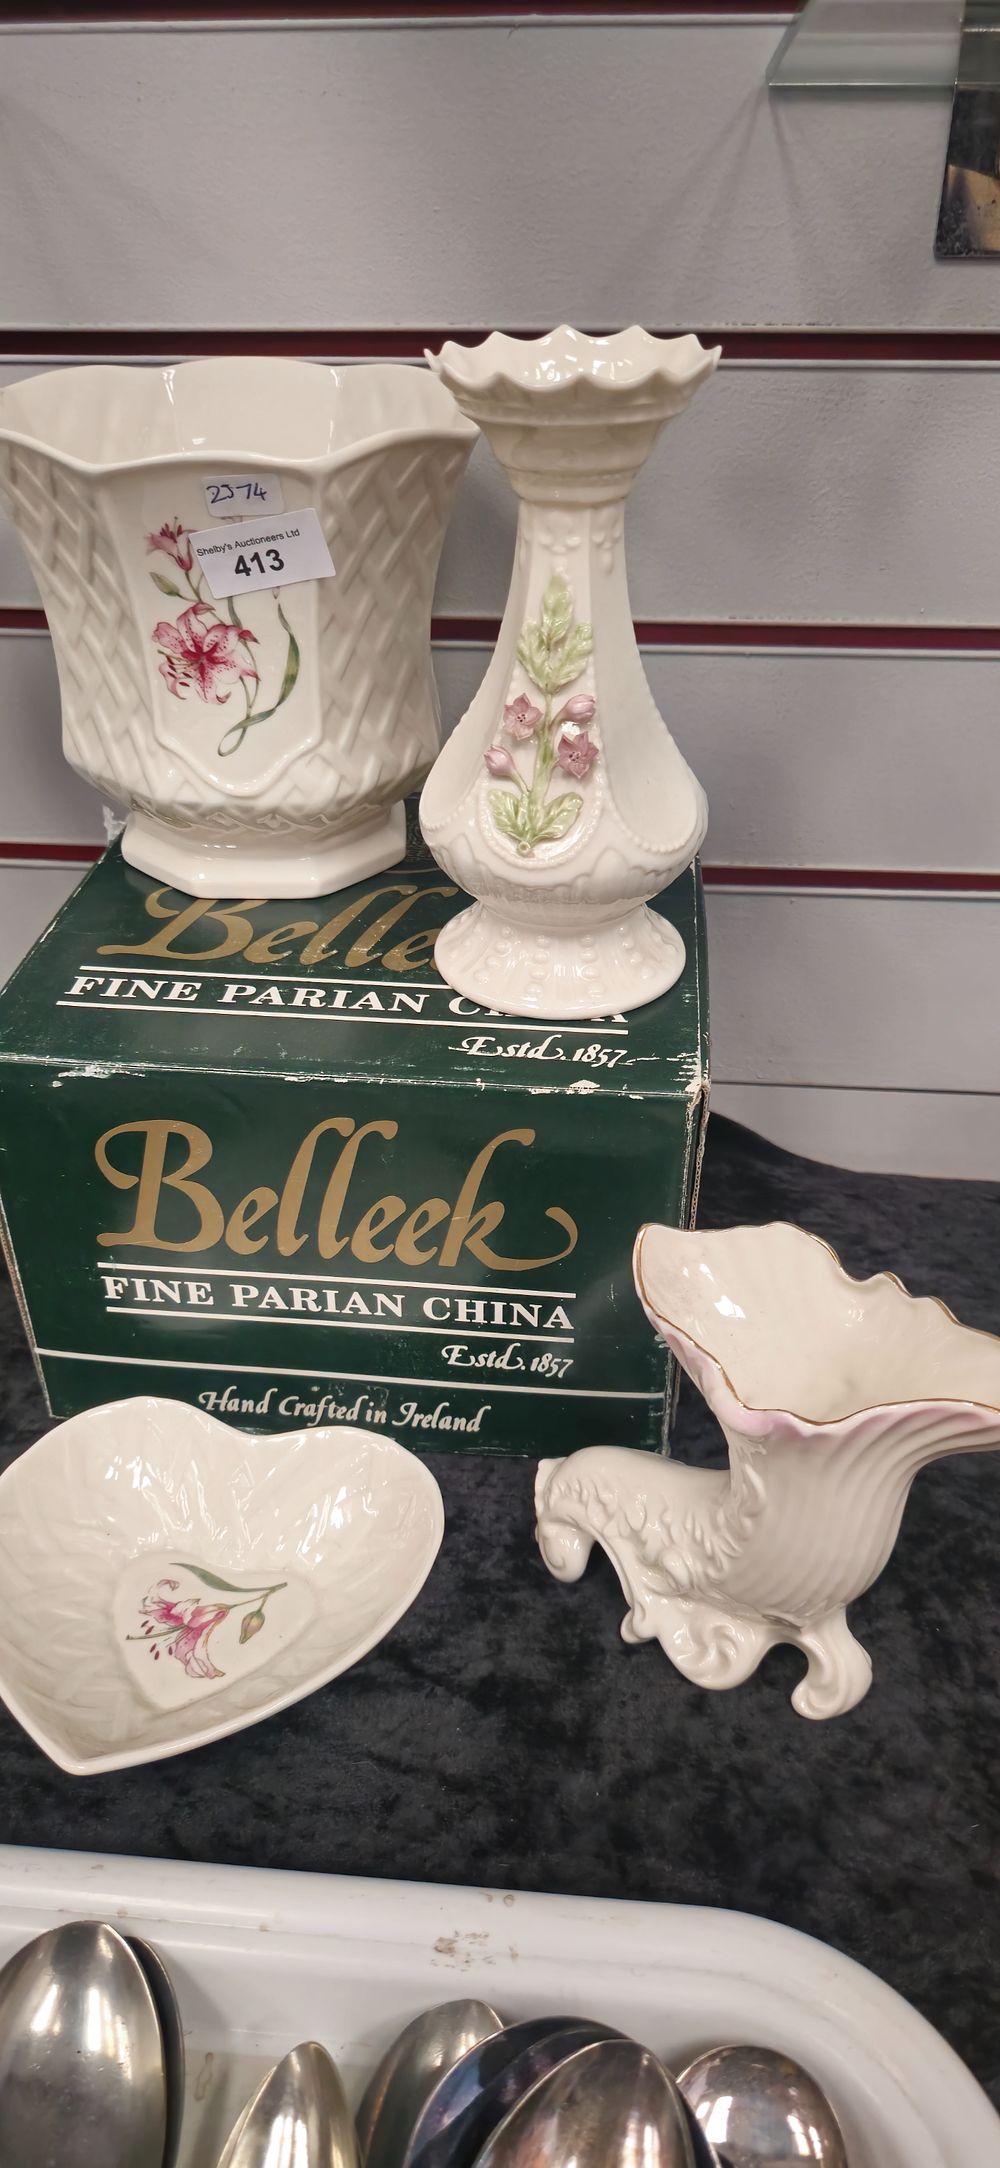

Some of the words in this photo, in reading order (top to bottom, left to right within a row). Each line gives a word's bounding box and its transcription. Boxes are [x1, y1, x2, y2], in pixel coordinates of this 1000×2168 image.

[197, 543, 233, 556] Shelby's
[234, 533, 285, 549] Auctioneers
[286, 528, 300, 538] Ltd
[234, 549, 285, 577] 413
[96, 884, 459, 972] Belle
[64, 976, 202, 1002] FINE
[216, 983, 430, 1013] PARIAN
[572, 1043, 628, 1069] 1857
[94, 1117, 578, 1270] Belleek
[102, 1276, 214, 1306] FINE
[230, 1284, 404, 1318] PARIAN
[422, 1296, 575, 1330] CHINA
[441, 1342, 527, 1371] Estd.
[529, 1352, 574, 1379] 1857
[198, 1385, 278, 1416] Hand
[279, 1395, 366, 1426] Crafted
[366, 1401, 387, 1424] in
[391, 1402, 492, 1433] Ireland
